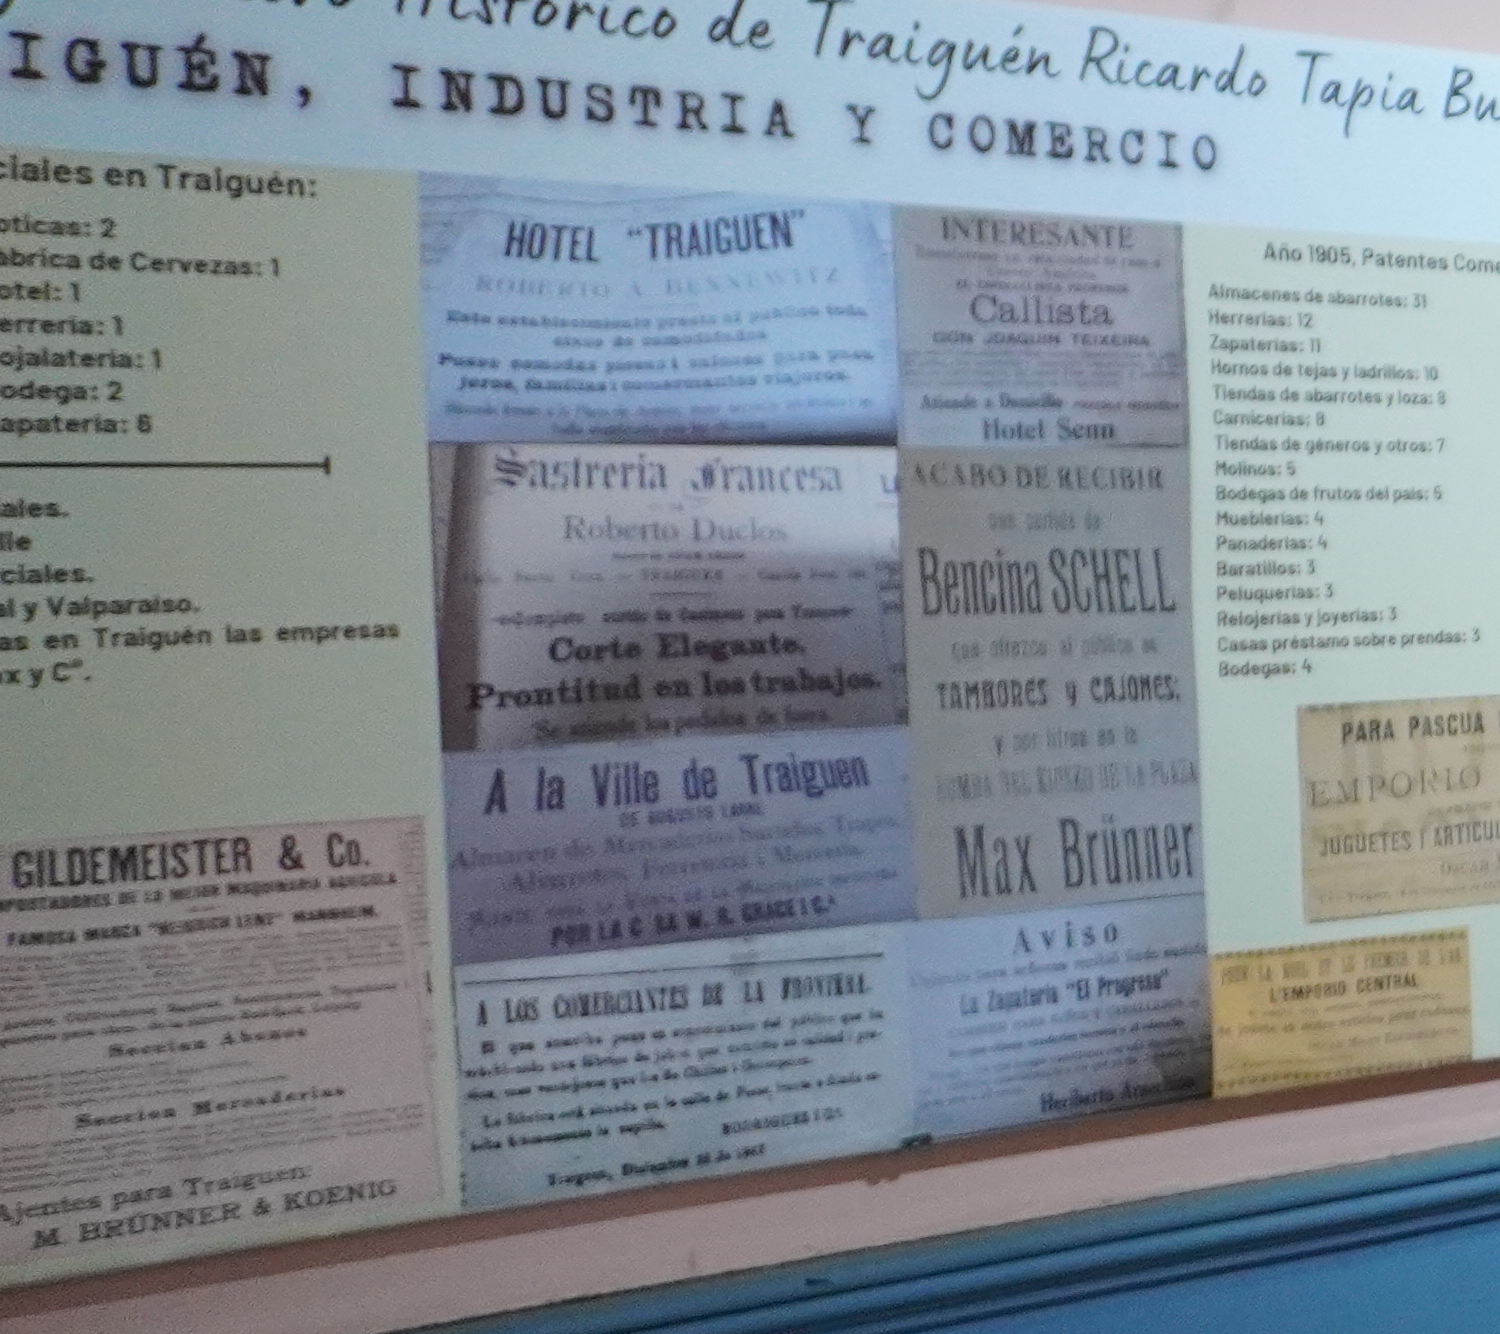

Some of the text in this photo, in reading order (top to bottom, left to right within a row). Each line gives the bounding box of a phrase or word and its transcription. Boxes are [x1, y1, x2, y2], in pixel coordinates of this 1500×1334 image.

[1078, 26, 1269, 99] Ricardo
[1295, 50, 1424, 138] Tapia
[391, 63, 797, 140] INDUSTRIA
[847, 104, 876, 144] Y
[929, 112, 1219, 172] COMERCIO
[105, 165, 147, 190] en
[503, 220, 599, 264] HOTEL
[941, 215, 1136, 250] INTERESANTE
[1263, 242, 1303, 263] Año
[1361, 246, 1449, 271] Patentes
[969, 293, 1115, 327] Callista
[1208, 283, 1301, 303] Almacenes
[1303, 285, 1324, 304] de
[982, 416, 1046, 442] Hotel
[918, 546, 1043, 617] Bencina
[1046, 546, 1178, 615] SCHELL
[275, 622, 400, 648] empresas
[548, 634, 642, 664] Corte
[464, 671, 641, 713] Prontitud
[654, 677, 692, 698] en
[1340, 718, 1396, 745] PARA
[1408, 711, 1485, 740] PASCUA
[483, 767, 508, 816] A
[535, 766, 566, 811] la
[590, 760, 660, 808] Ville
[683, 755, 718, 801] de
[1308, 767, 1483, 809] EMPORIO
[1319, 829, 1412, 858] JUGUETES
[11, 836, 254, 890] GILDEMEISTER
[278, 834, 305, 871] &
[953, 824, 1039, 900] Max
[1012, 920, 1120, 956] Aviso
